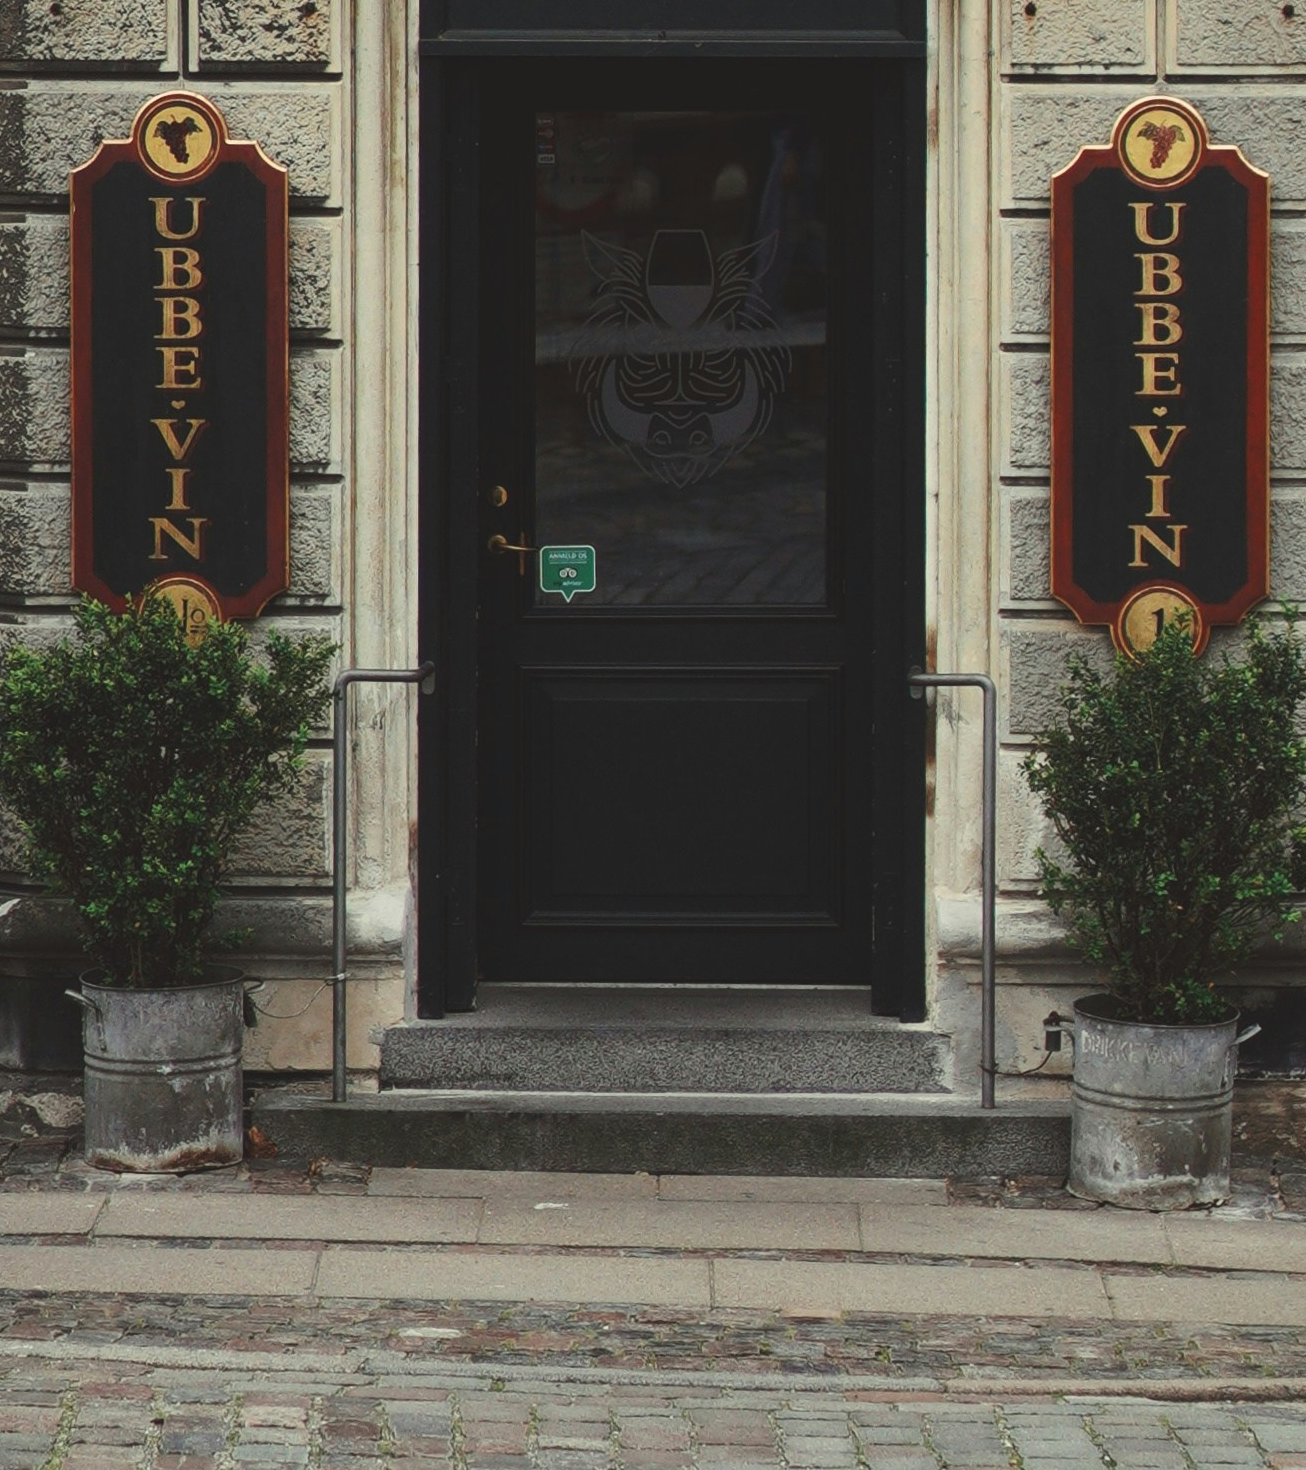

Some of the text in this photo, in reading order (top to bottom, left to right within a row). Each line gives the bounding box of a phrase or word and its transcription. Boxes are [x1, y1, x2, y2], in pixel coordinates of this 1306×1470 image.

[148, 196, 210, 560] UBBE VIN
[1128, 201, 1189, 568] UBBE VIN
